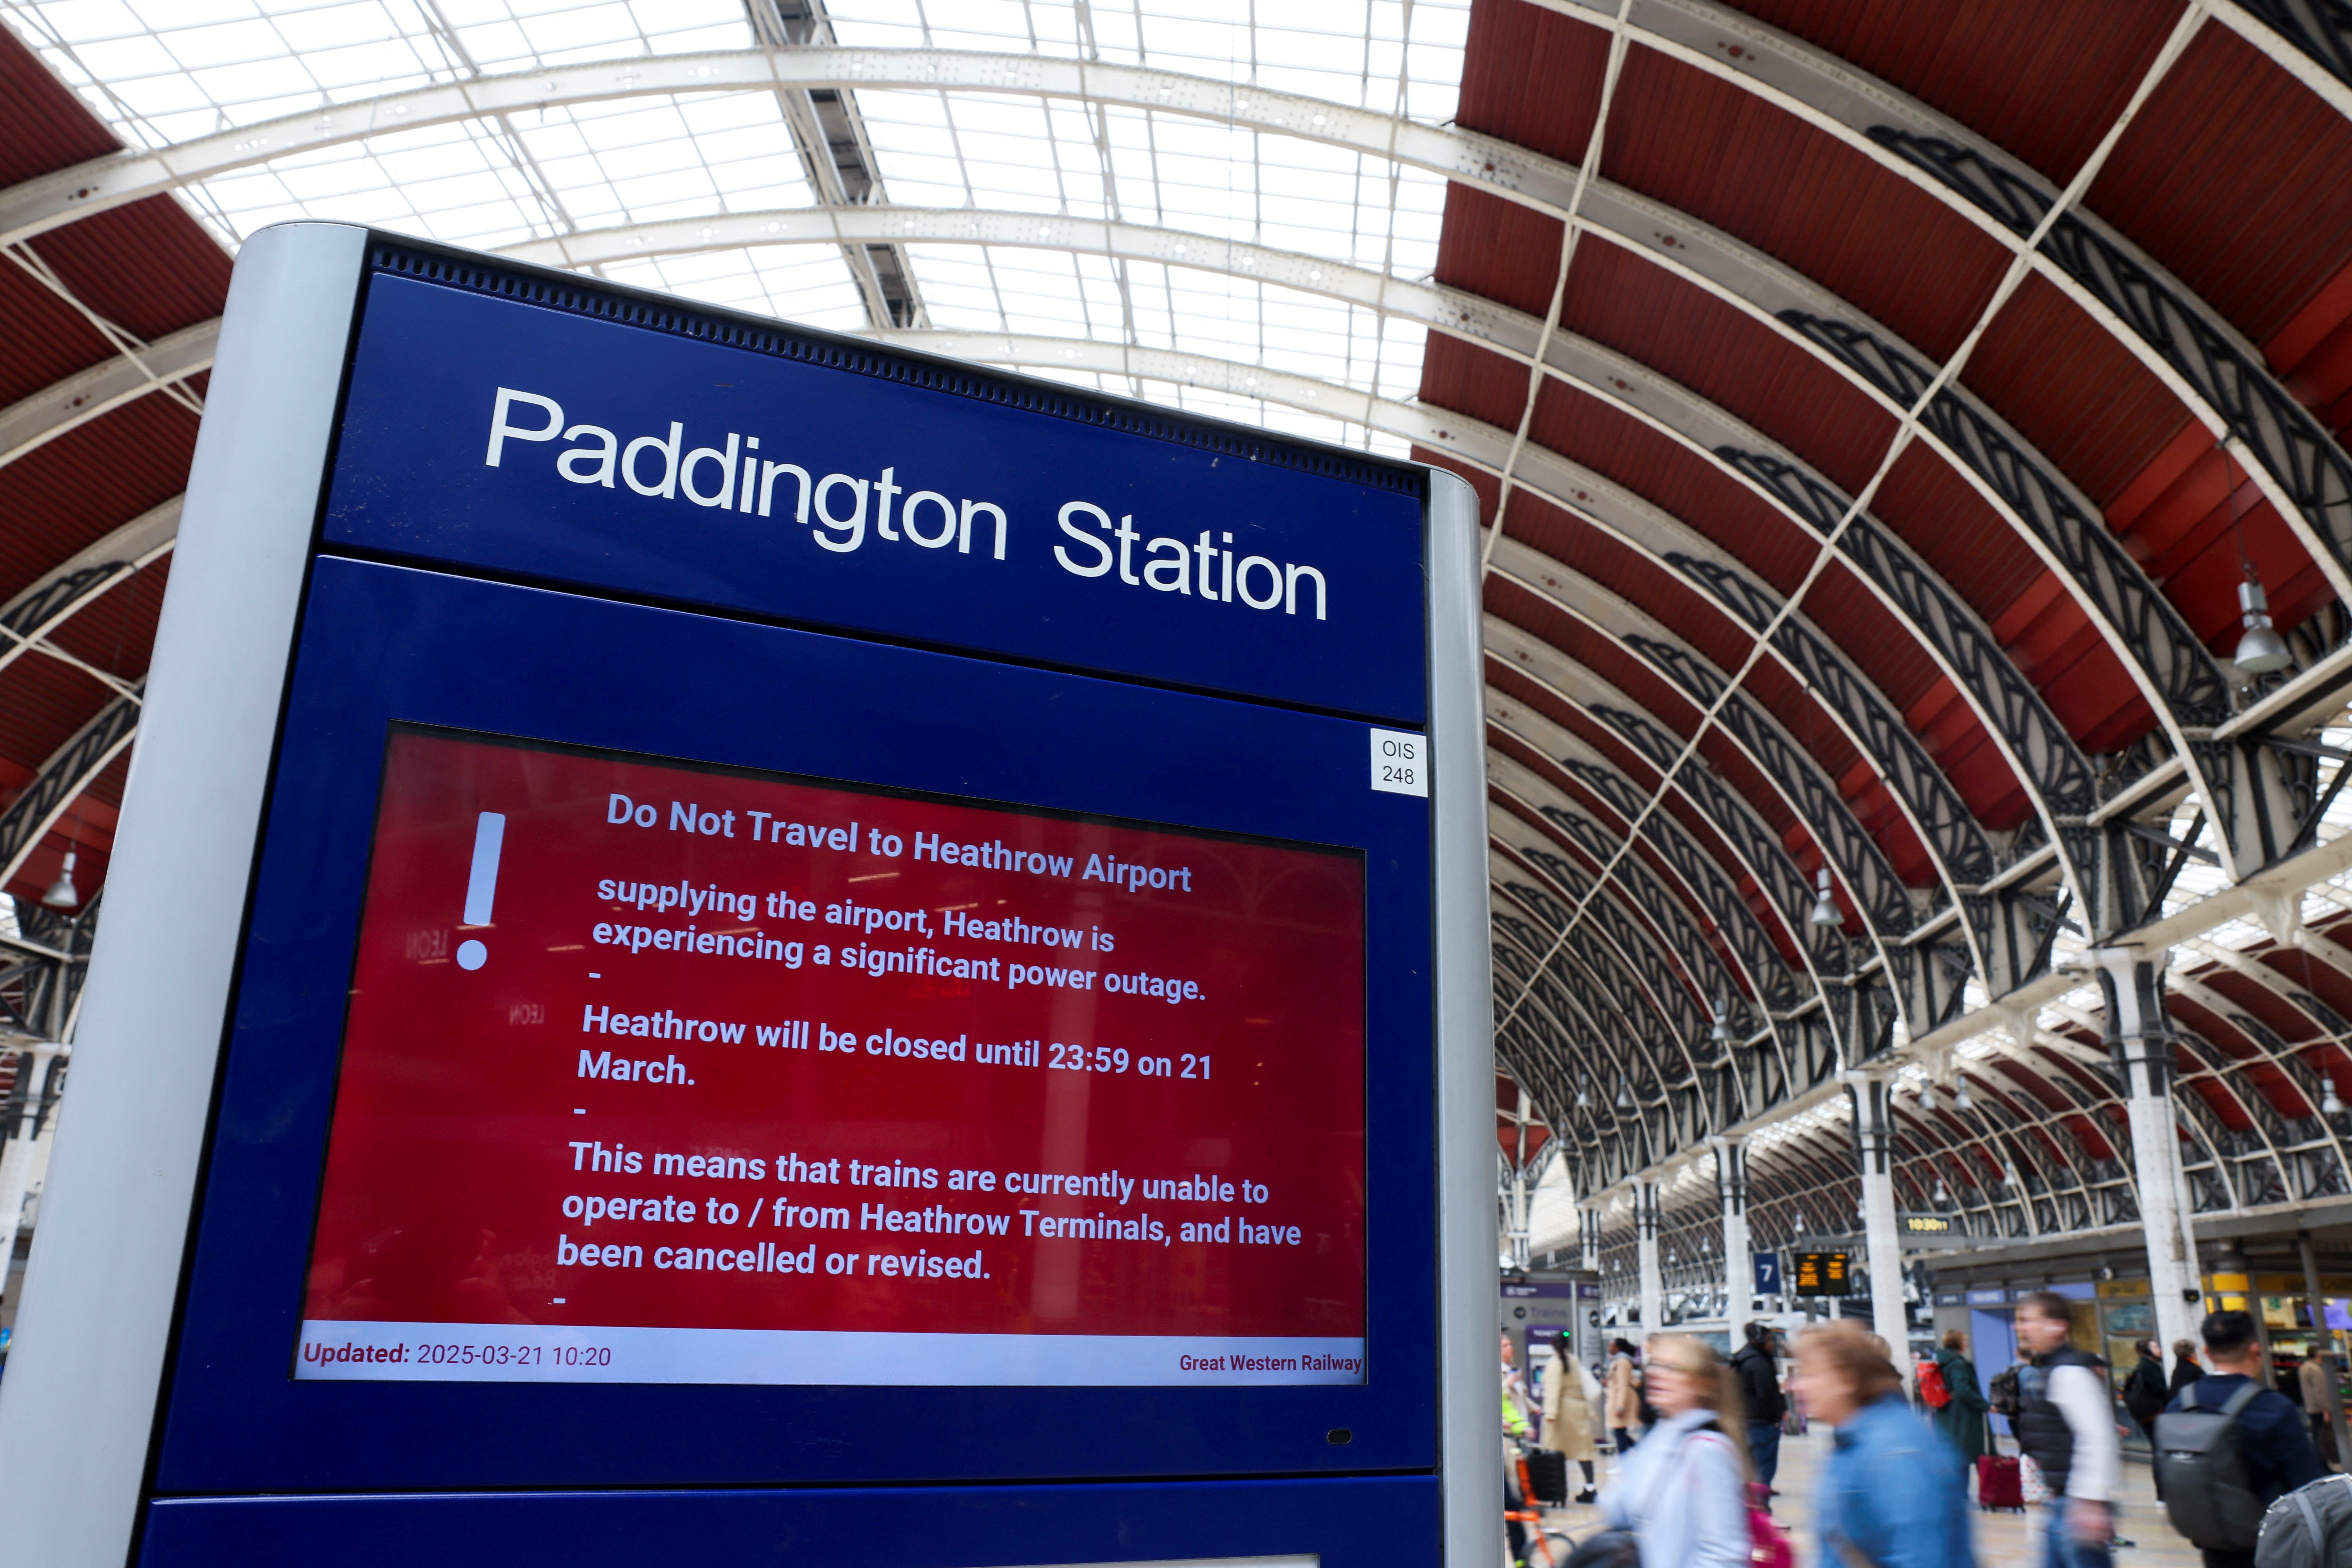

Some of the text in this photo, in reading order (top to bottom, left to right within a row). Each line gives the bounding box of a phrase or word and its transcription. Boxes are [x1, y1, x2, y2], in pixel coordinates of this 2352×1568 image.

[485, 387, 1326, 621] Paddington Station
[1383, 740, 1414, 759] OIS
[1383, 766, 1414, 784] 248
[608, 794, 1191, 892] Do Not Travel to Heathrow Airport
[597, 880, 1114, 951] supplying the airport, Heathrow is
[593, 923, 1205, 1004] experiencing a significant power outage.
[583, 1005, 1210, 1079] Heathrow will be closed until 23:59 on 21
[578, 1050, 695, 1085] March.
[569, 1142, 642, 1173] This
[654, 1154, 766, 1180] means
[776, 1153, 840, 1184] that
[849, 1160, 938, 1189] trains
[948, 1170, 996, 1191] are
[1005, 1171, 1134, 1205] currently
[1143, 1174, 1234, 1202] unable
[1242, 1180, 1268, 1203] to
[563, 1196, 1301, 1247] operate to / from Heathrow Terminals, and have
[557, 1234, 989, 1279] been cancelled or revised.
[1760, 1264, 1773, 1282] 7
[304, 1342, 611, 1367] Updated: 2025-03-21 10:20
[1180, 1354, 1362, 1374] Great Western Railway
